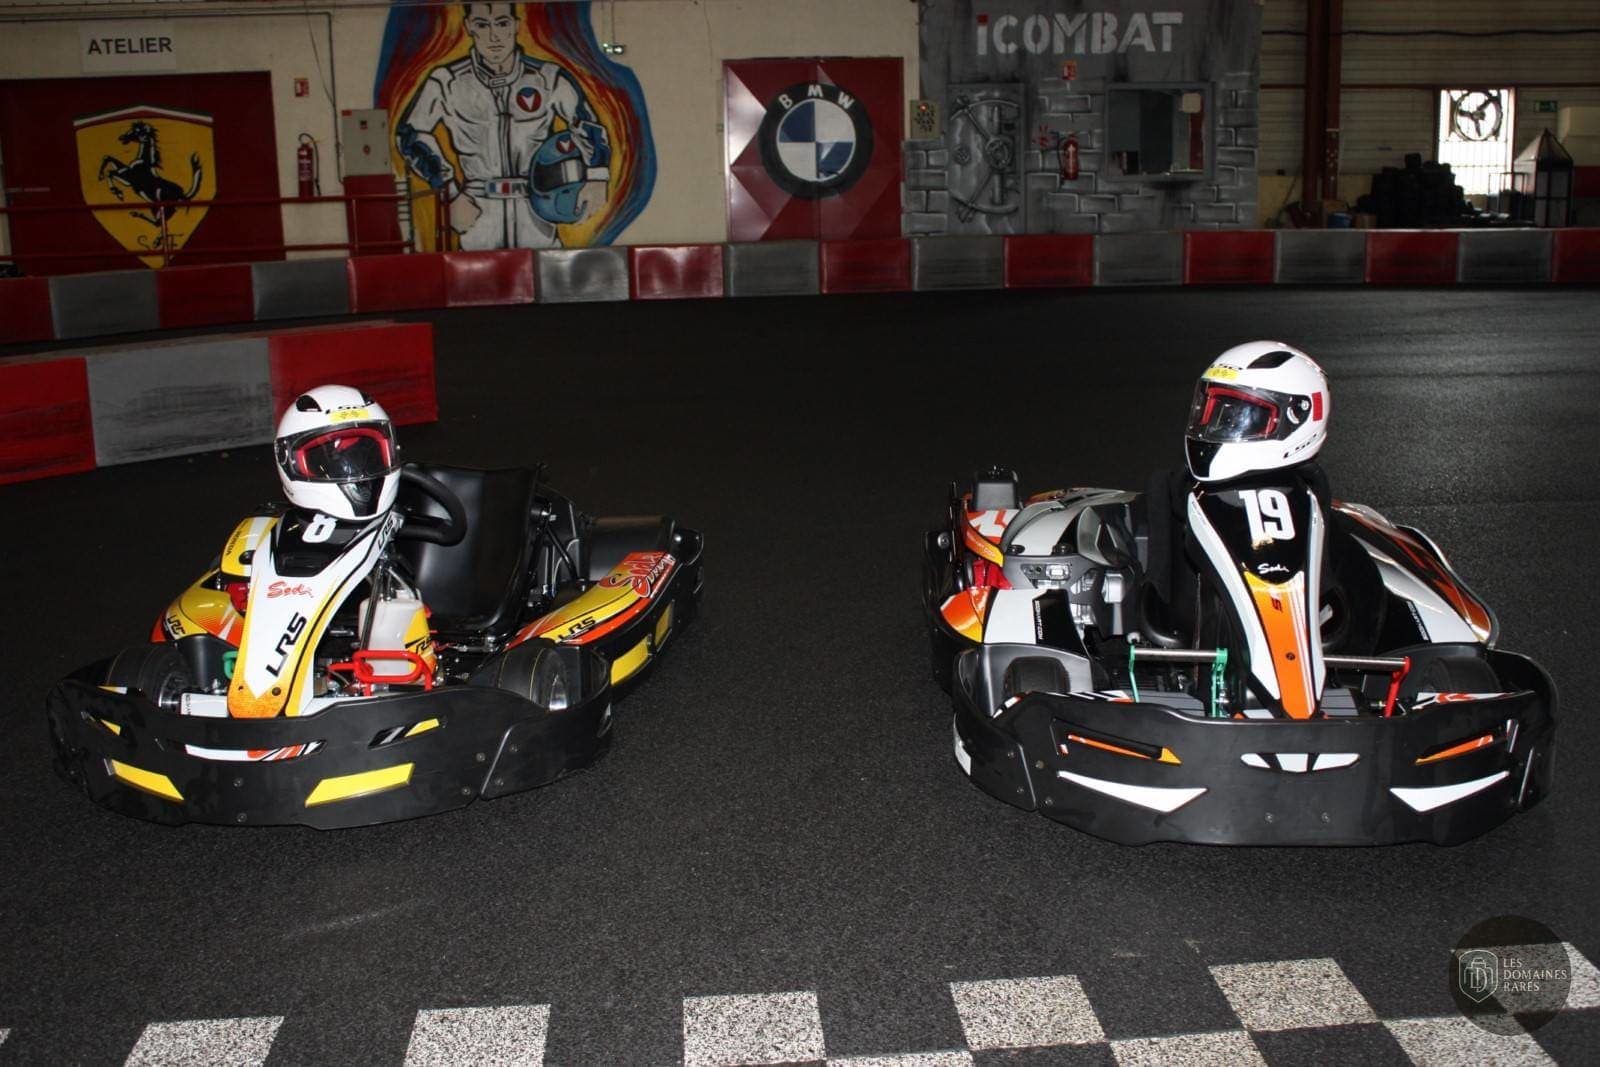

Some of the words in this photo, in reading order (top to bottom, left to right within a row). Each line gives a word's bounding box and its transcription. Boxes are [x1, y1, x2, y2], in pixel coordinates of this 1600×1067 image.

[88, 36, 172, 54] ATELIER
[976, 12, 1183, 55] iCOMBAT
[1238, 489, 1296, 543] 19
[267, 581, 314, 599] Sodi
[265, 612, 307, 677] LRS
[558, 616, 596, 640] LRS
